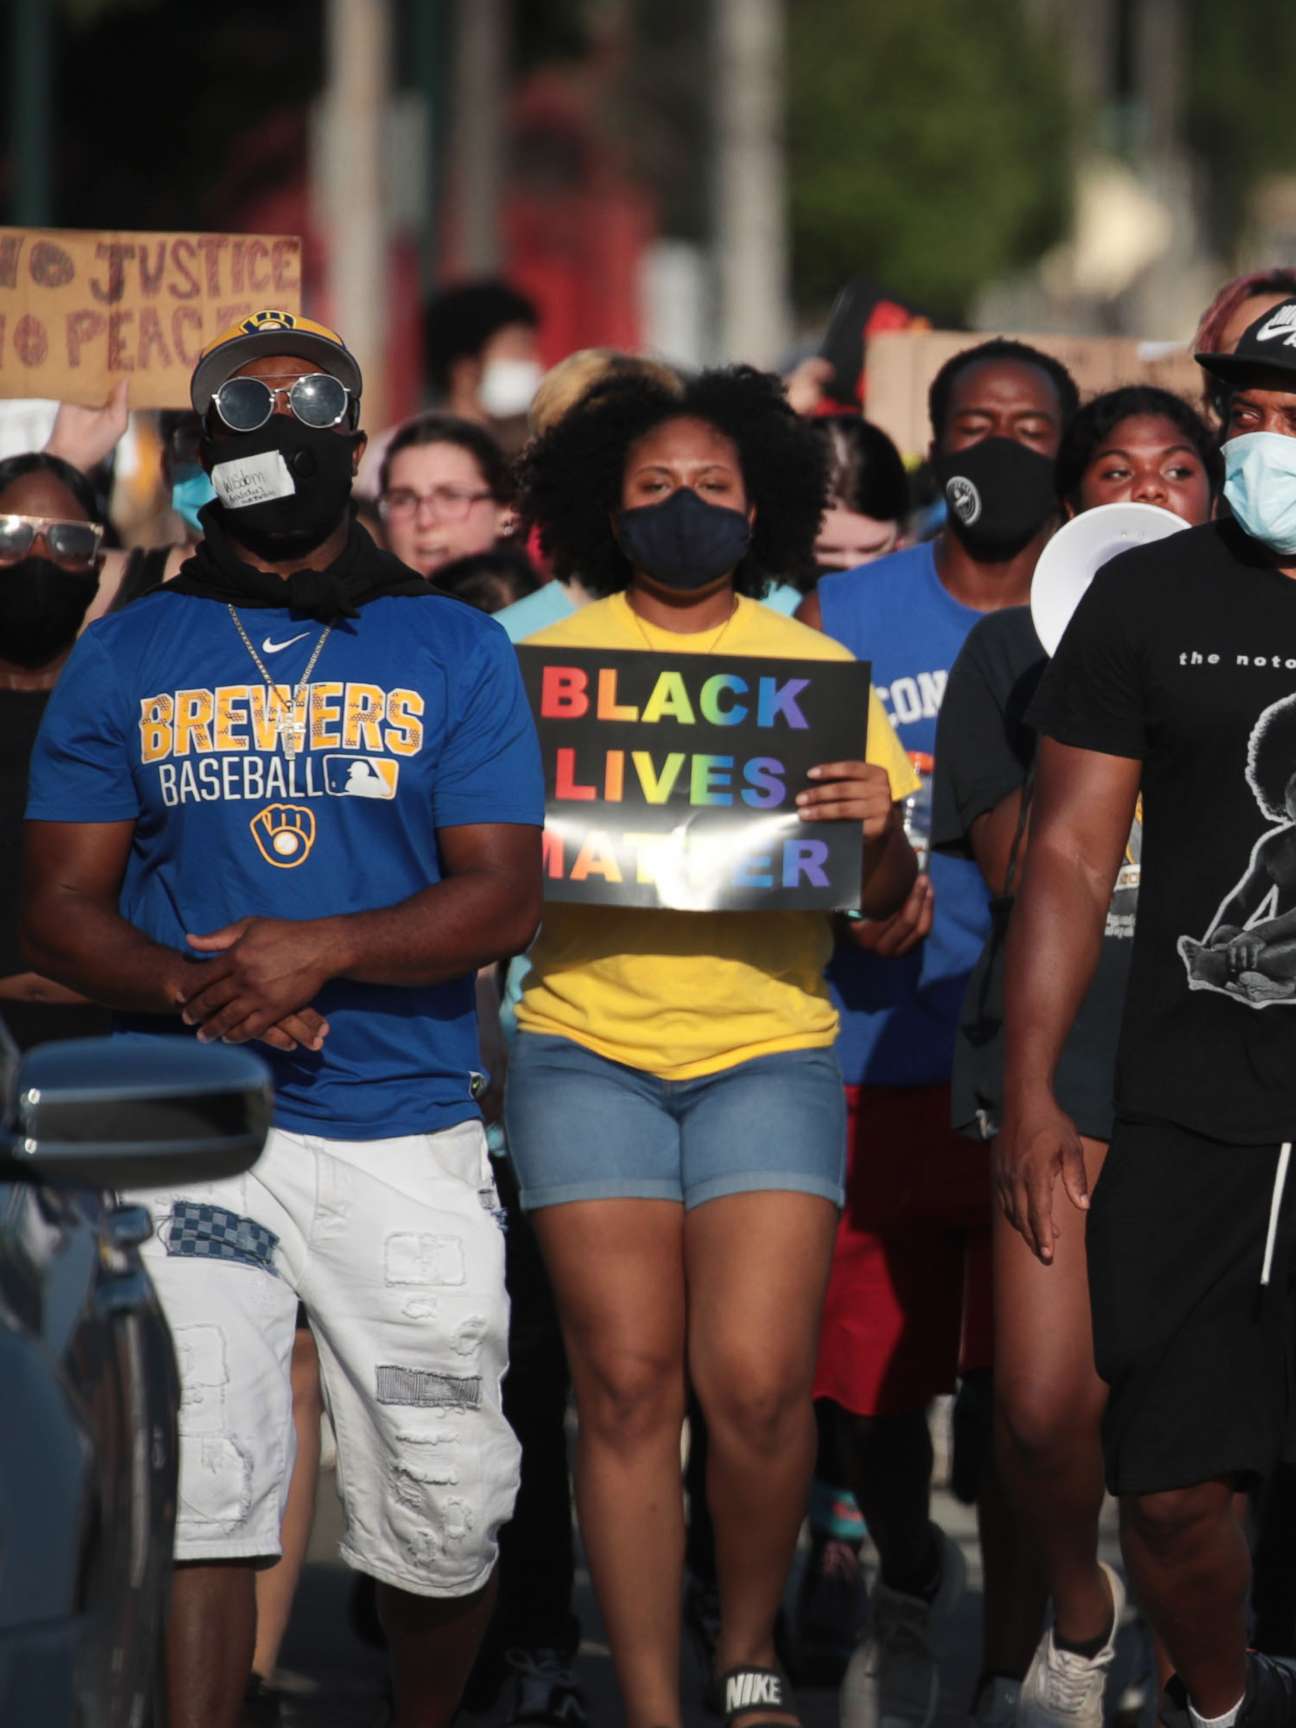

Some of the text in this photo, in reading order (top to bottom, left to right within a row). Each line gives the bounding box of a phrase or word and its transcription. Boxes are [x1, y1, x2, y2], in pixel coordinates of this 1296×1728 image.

[89, 235, 300, 306] JUSTICE
[0, 313, 49, 369] O
[1179, 650, 1221, 666] the
[138, 682, 425, 764] BREWERS
[541, 666, 812, 730] BLACK
[158, 756, 324, 807] BASEBALL
[555, 748, 787, 809] LIVES
[726, 1672, 781, 1713] NIKE
